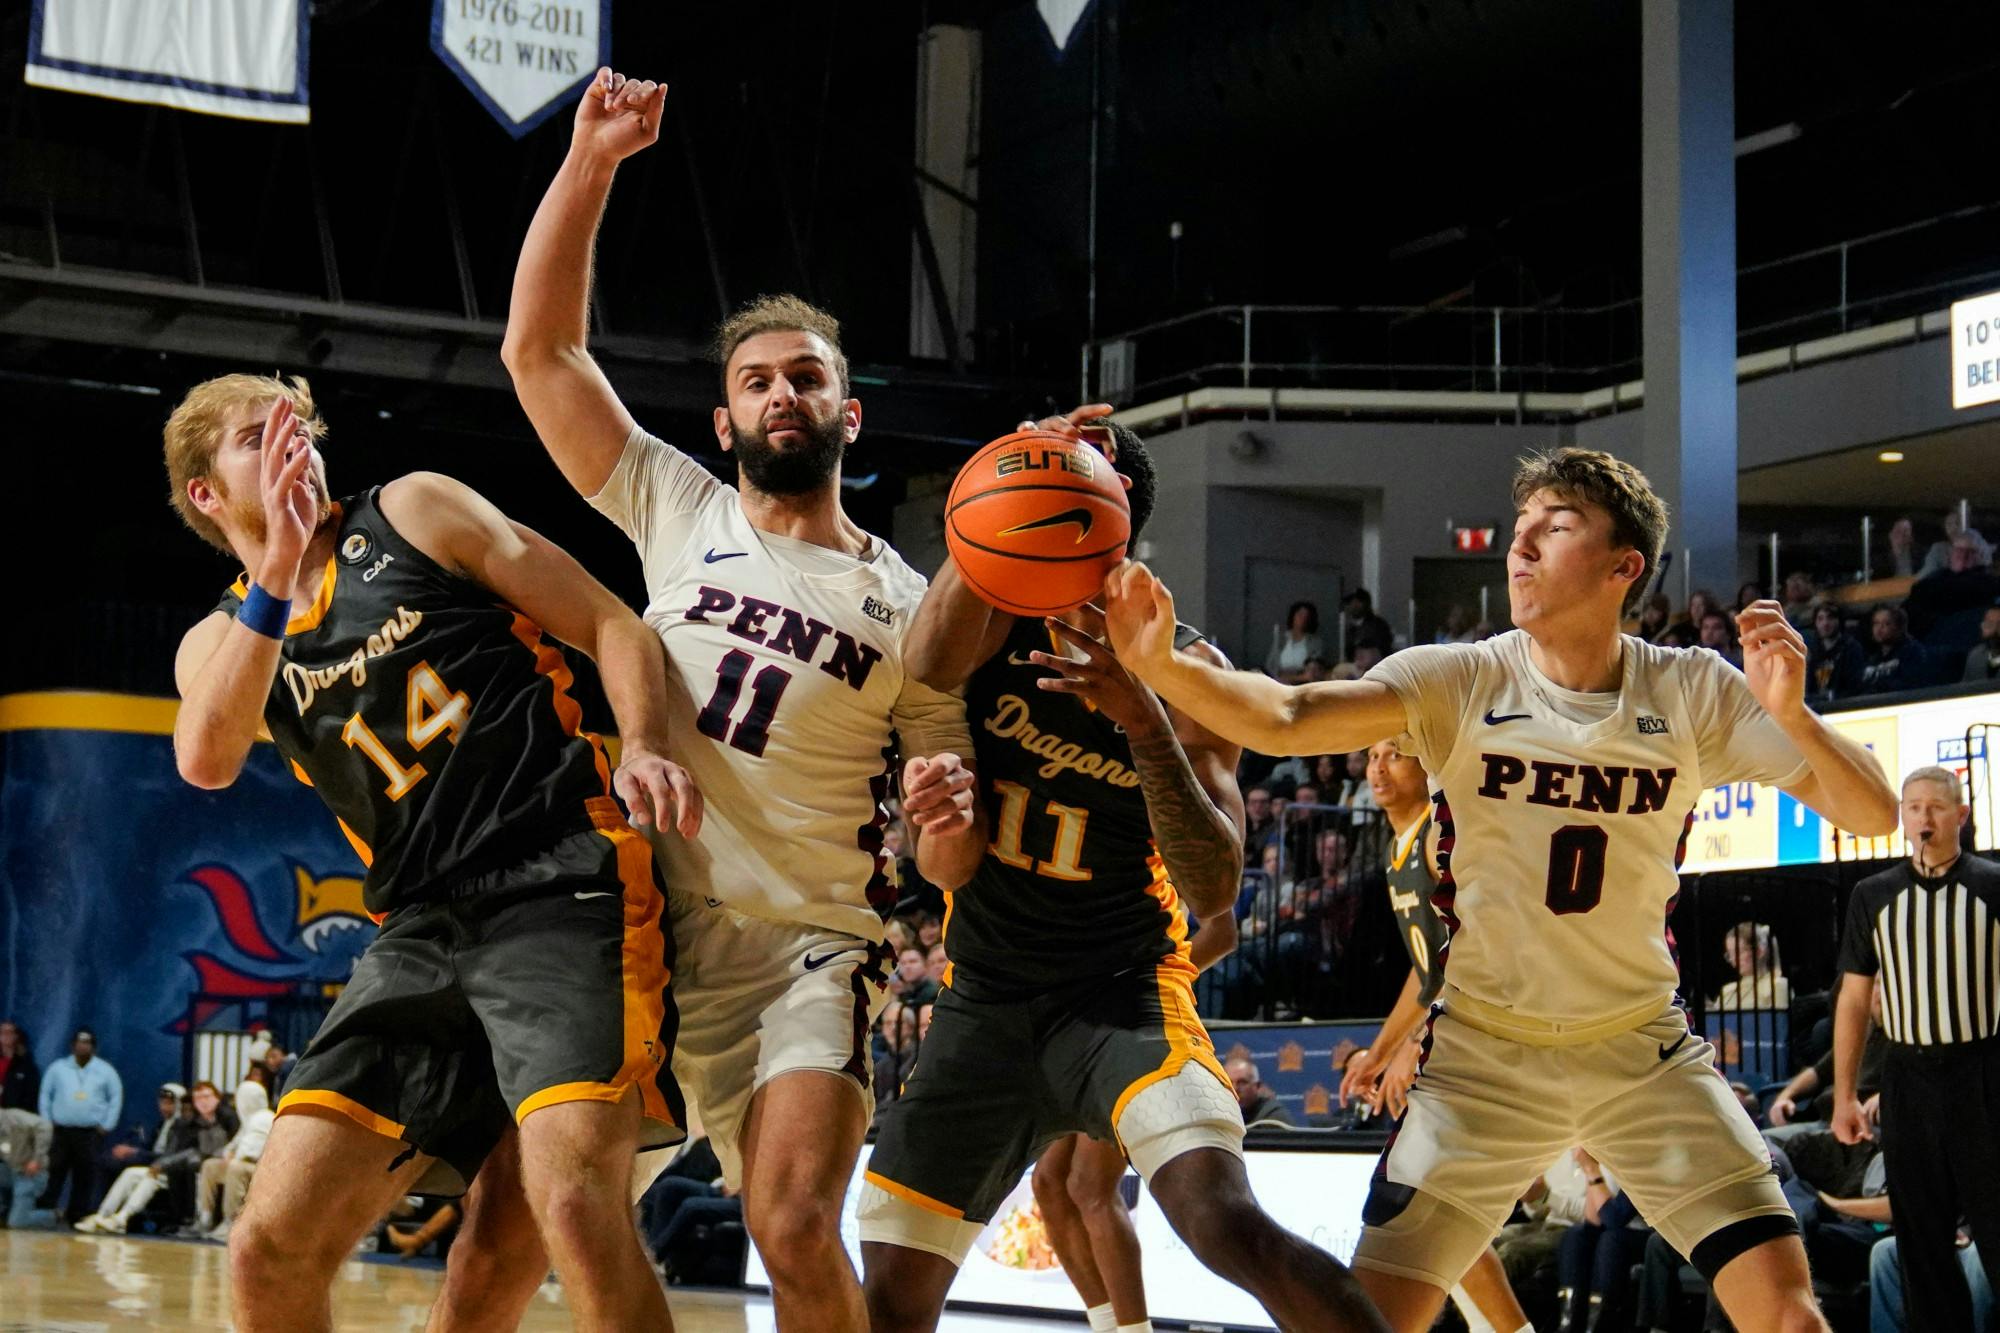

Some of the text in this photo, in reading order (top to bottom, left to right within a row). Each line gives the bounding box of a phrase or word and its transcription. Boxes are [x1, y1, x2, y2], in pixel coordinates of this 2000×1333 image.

[460, 0, 583, 37] 1976-2011
[465, 34, 579, 75] 421 WINS
[996, 451, 1094, 481] ELITE
[362, 553, 395, 583] CAA
[684, 585, 883, 691] PENN
[340, 659, 473, 803] 14
[696, 648, 792, 758] 11
[984, 694, 1141, 788] Dragons
[1478, 753, 1677, 815] PENN
[987, 779, 1093, 881] 11
[1545, 825, 1609, 916] 0
[1410, 925, 1429, 972] 0
